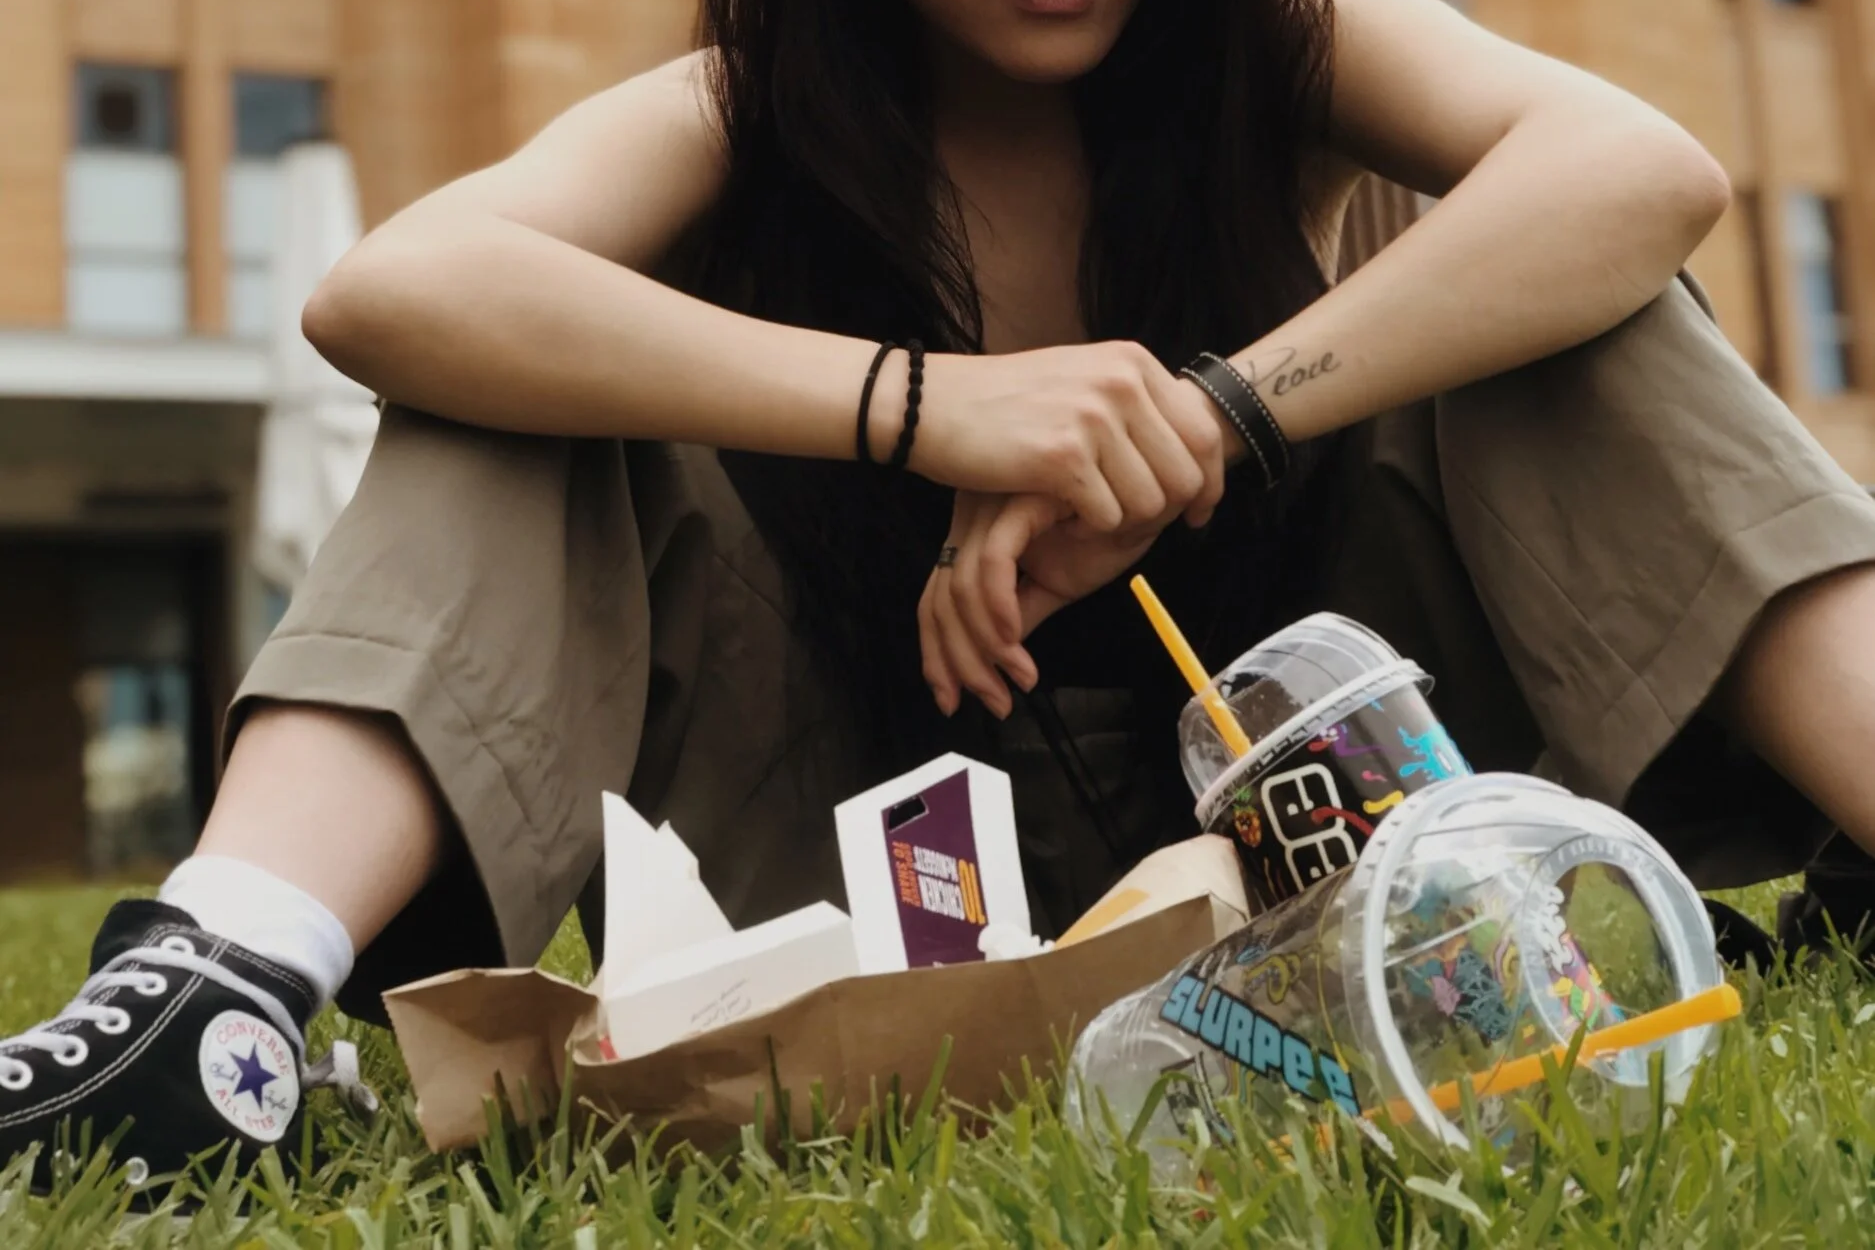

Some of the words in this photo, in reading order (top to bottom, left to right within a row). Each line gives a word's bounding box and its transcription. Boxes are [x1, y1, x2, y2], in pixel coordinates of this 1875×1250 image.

[1247, 346, 1342, 397] Peace
[216, 1021, 289, 1075] CONVERSE
[216, 1089, 238, 1116] ALL
